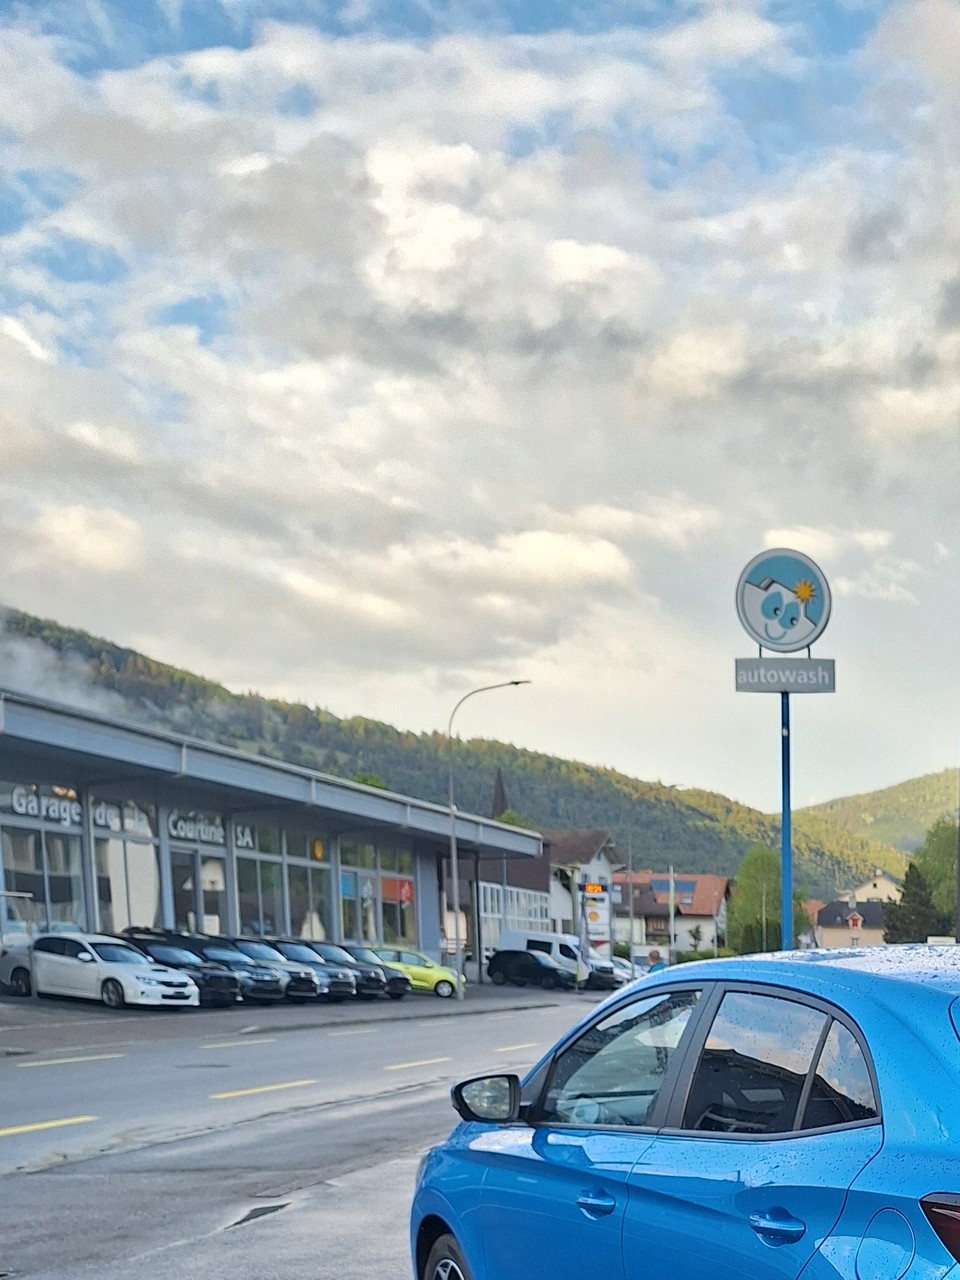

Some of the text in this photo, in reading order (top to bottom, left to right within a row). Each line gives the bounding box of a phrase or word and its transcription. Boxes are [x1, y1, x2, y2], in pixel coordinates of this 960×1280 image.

[737, 666, 829, 685] autowash
[12, 785, 81, 827] Garage
[94, 801, 117, 829] de
[167, 811, 226, 845] Courtine
[236, 824, 255, 849] SA
